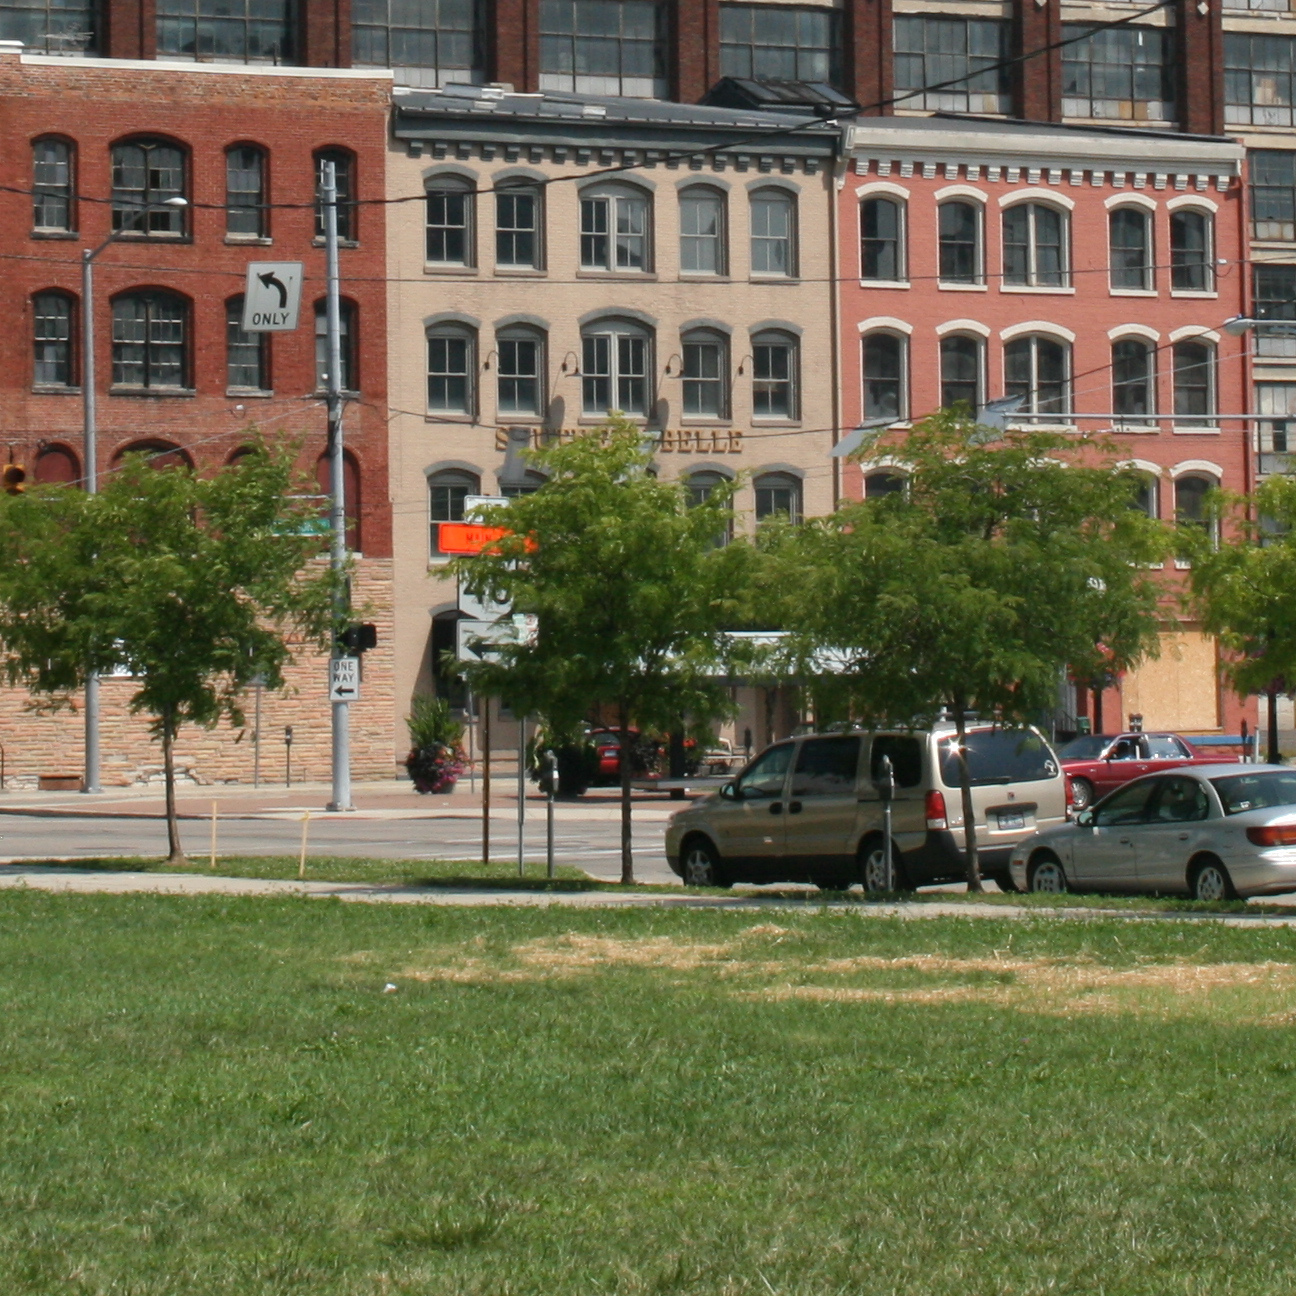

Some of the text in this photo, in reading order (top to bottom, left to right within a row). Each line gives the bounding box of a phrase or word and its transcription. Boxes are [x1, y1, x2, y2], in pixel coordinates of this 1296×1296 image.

[252, 312, 290, 326] ONLY
[660, 429, 743, 453] BELLE
[333, 661, 354, 672] ONE
[333, 672, 355, 683] WAY
